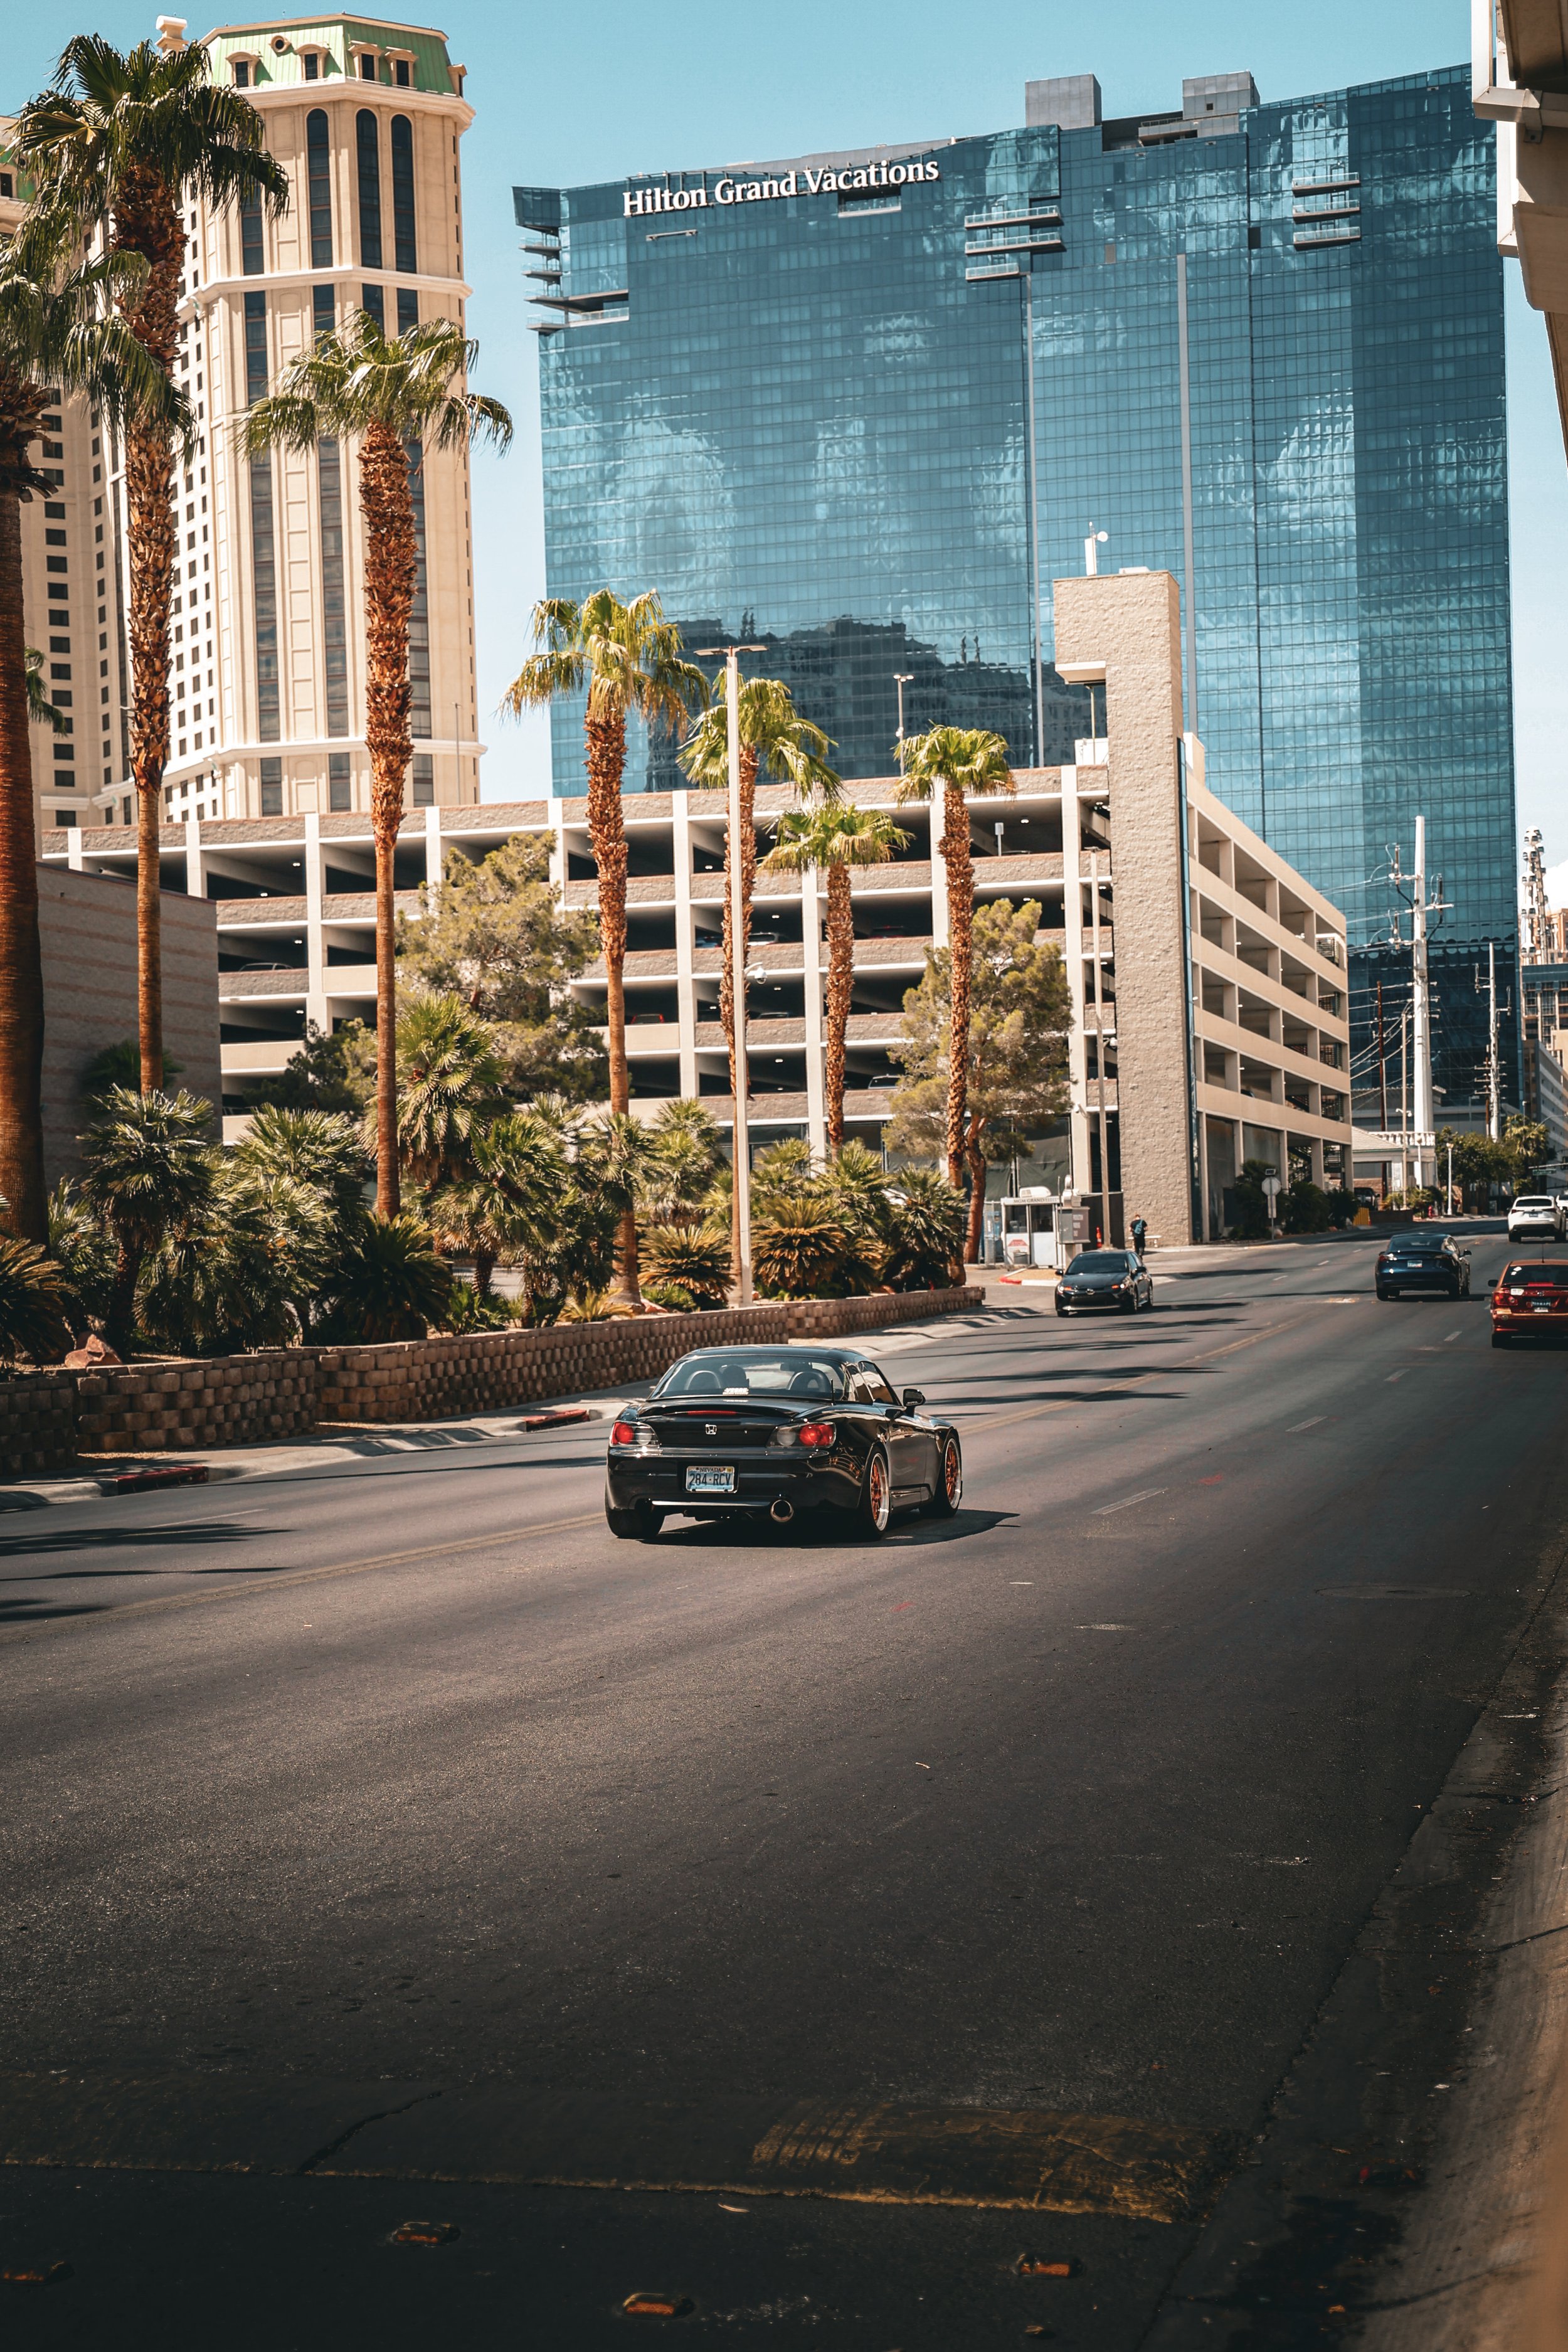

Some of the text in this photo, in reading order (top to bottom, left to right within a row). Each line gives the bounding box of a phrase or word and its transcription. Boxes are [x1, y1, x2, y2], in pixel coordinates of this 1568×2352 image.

[623, 160, 940, 216] Hilton Grand Vacations
